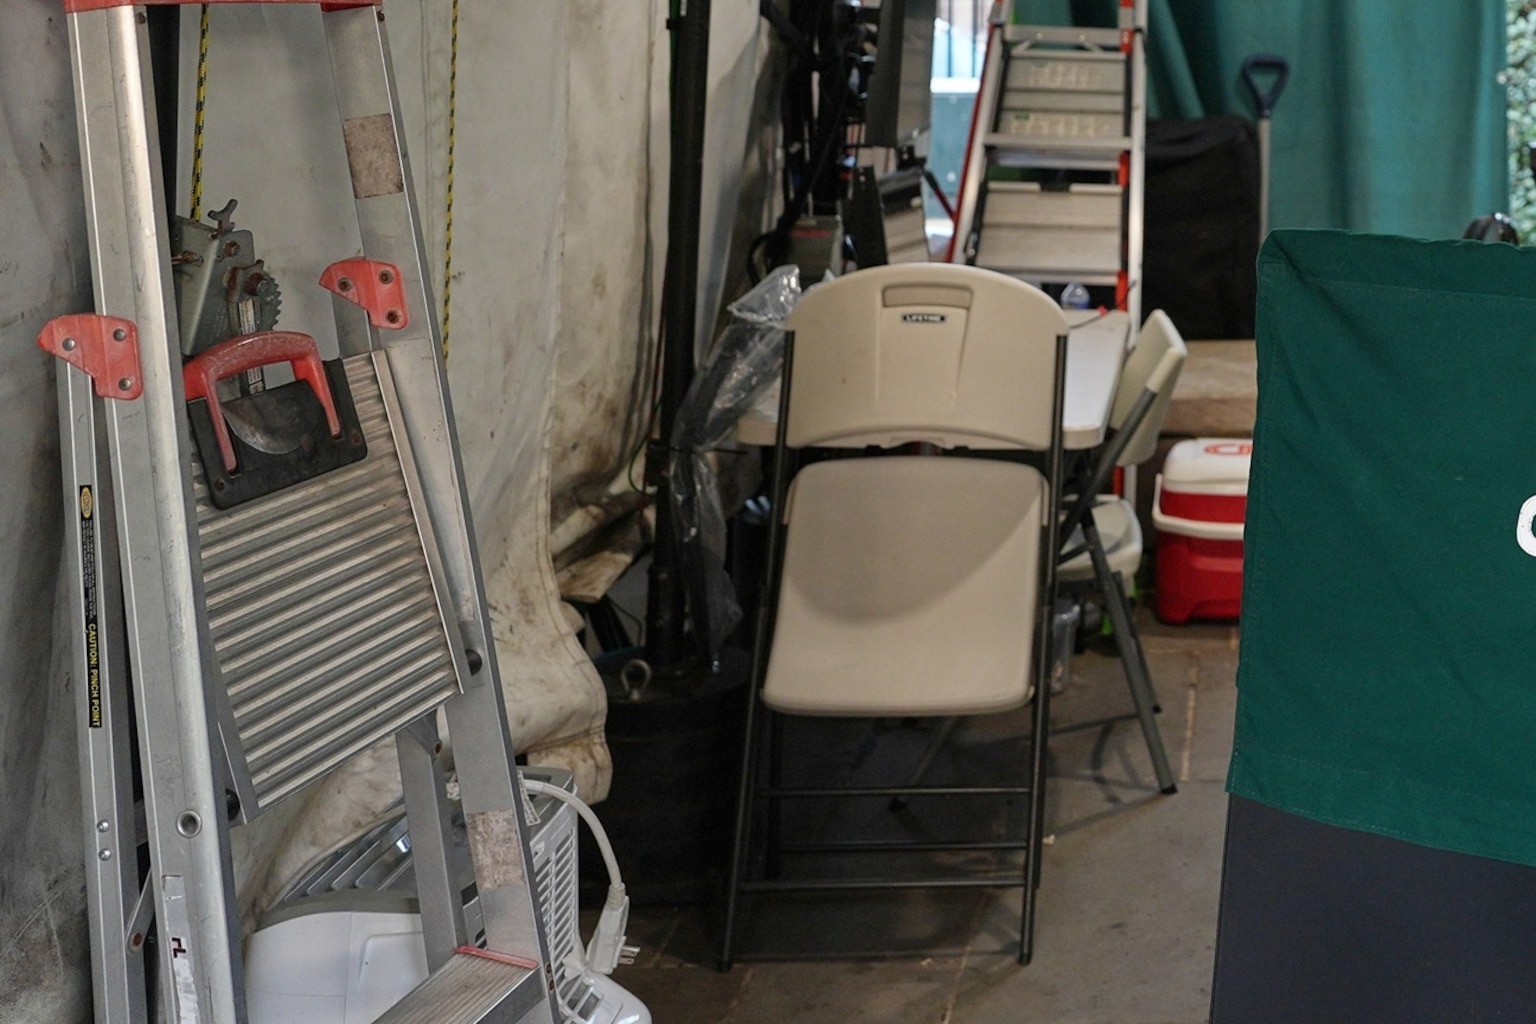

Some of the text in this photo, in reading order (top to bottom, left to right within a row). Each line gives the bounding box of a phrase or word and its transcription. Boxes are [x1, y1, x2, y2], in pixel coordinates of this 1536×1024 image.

[88, 623, 98, 668] CAUTION:
[90, 669, 99, 697] PINCH
[92, 699, 100, 727] POINT
